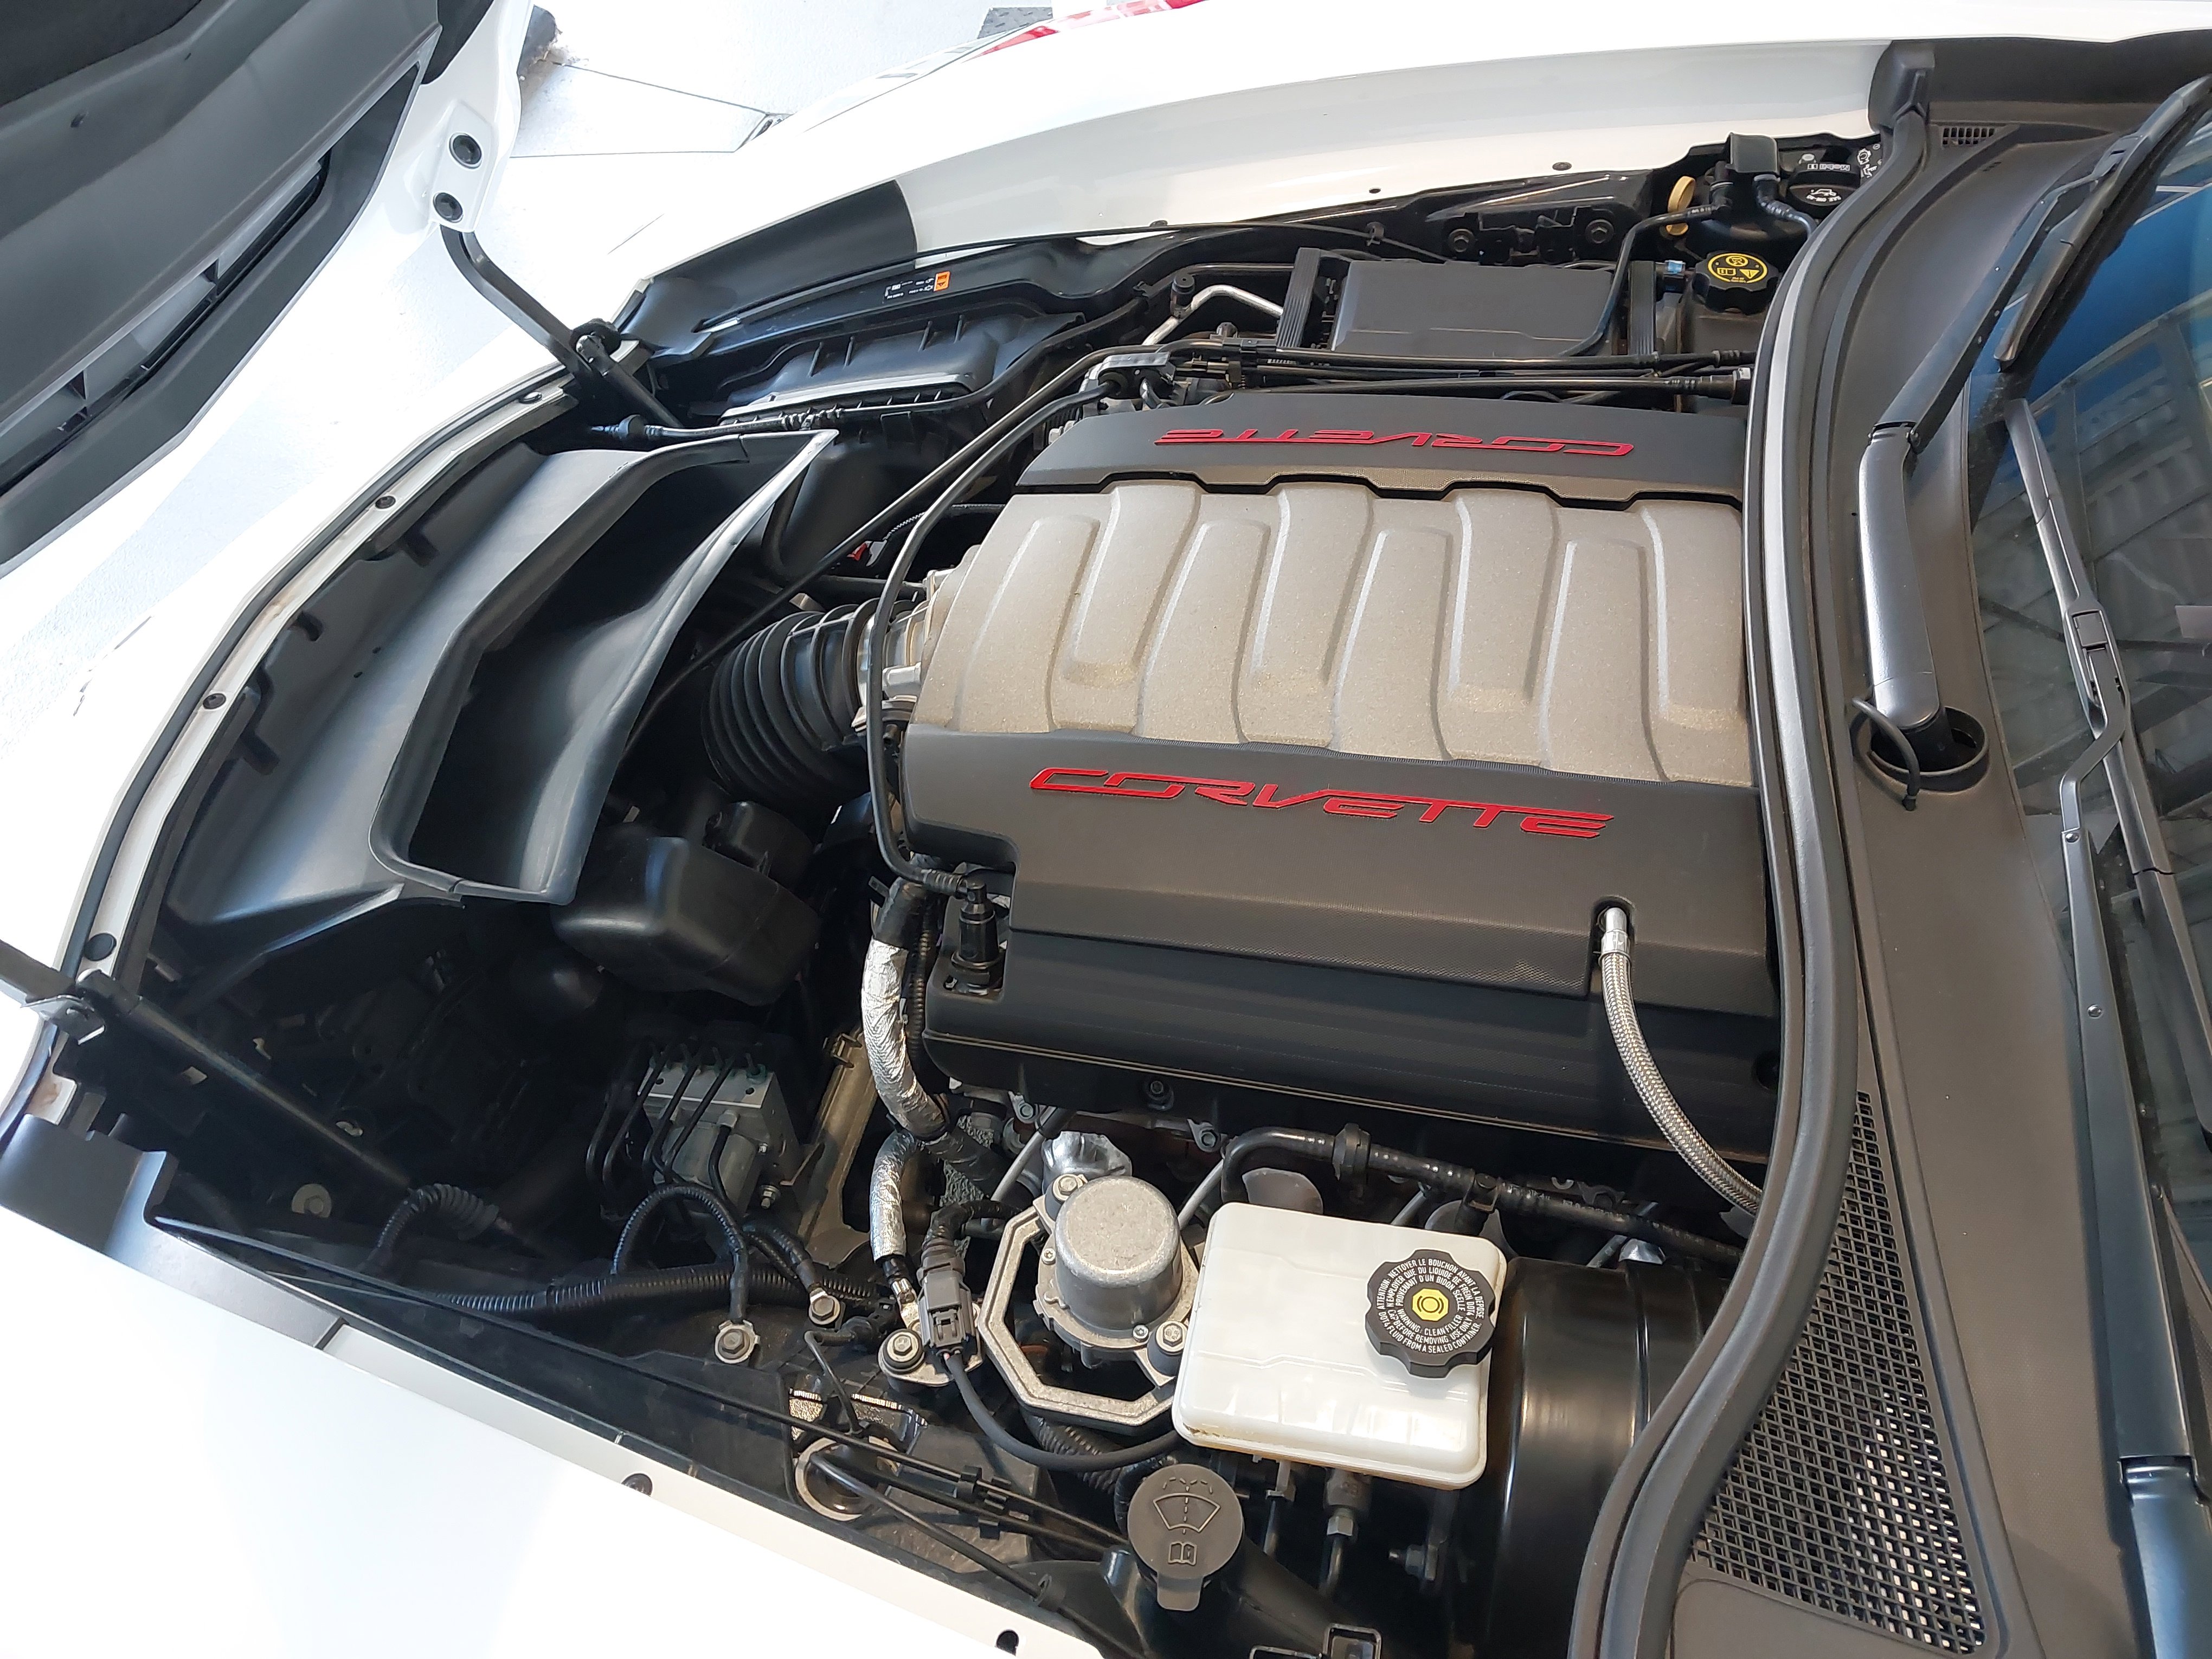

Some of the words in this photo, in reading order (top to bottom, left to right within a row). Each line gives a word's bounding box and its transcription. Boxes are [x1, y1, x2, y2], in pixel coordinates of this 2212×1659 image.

[1819, 163, 1850, 171] Mobil
[1154, 429, 1634, 456] CORVETTE
[1030, 767, 1614, 838] CORVETTE
[1387, 1259, 1417, 1278] NETTOYER
[1428, 1258, 1458, 1274] BOUCHON
[1457, 1270, 1476, 1287] AVANT
[1471, 1287, 1481, 1296] LA
[1395, 1276, 1418, 1307] PROVENANT
[1419, 1274, 1435, 1283] D'UN
[1436, 1276, 1456, 1291] BIDON
[1404, 1268, 1418, 1279] QUE
[1418, 1266, 1426, 1274] DU
[1429, 1266, 1453, 1279] LIQUIDE
[1451, 1276, 1462, 1285] DE
[1458, 1283, 1474, 1301] FREIN
[1378, 1311, 1391, 1327] DOT4
[1386, 1325, 1404, 1342] FLUID
[1402, 1338, 1422, 1352] FROM
[1427, 1343, 1454, 1354] SEALED
[1387, 1309, 1399, 1321] CAP
[1393, 1320, 1416, 1339] BEFORE
[1449, 1328, 1463, 1340] USE
[1459, 1316, 1473, 1332] ONLY
[1424, 1327, 1446, 1336] CLEAN
[1444, 1314, 1464, 1333] FILLER
